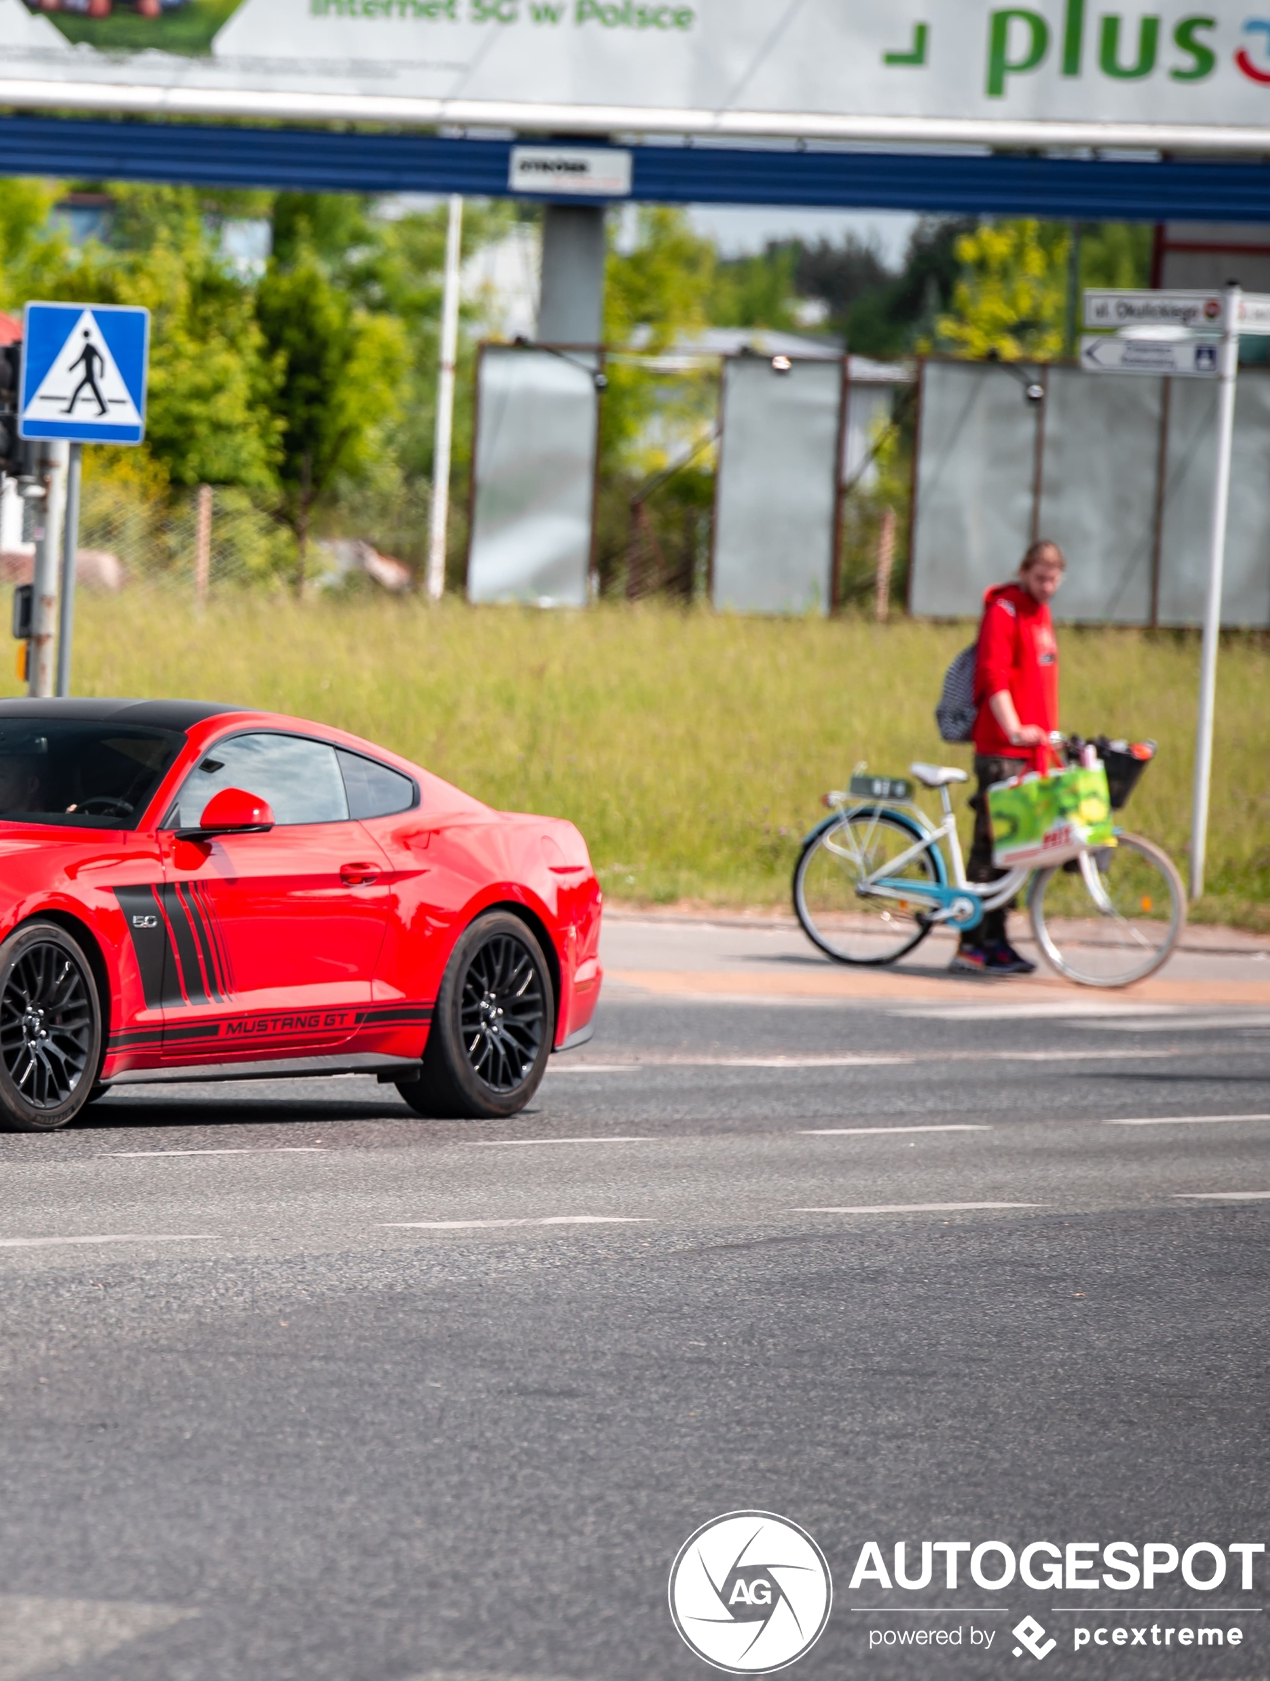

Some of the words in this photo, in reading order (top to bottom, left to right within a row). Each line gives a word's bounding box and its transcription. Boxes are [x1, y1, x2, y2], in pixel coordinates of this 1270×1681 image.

[576, 0, 695, 30] Polsce
[986, 0, 1217, 98] plus
[225, 1014, 322, 1035] MUSTANG
[323, 1013, 349, 1026] GT
